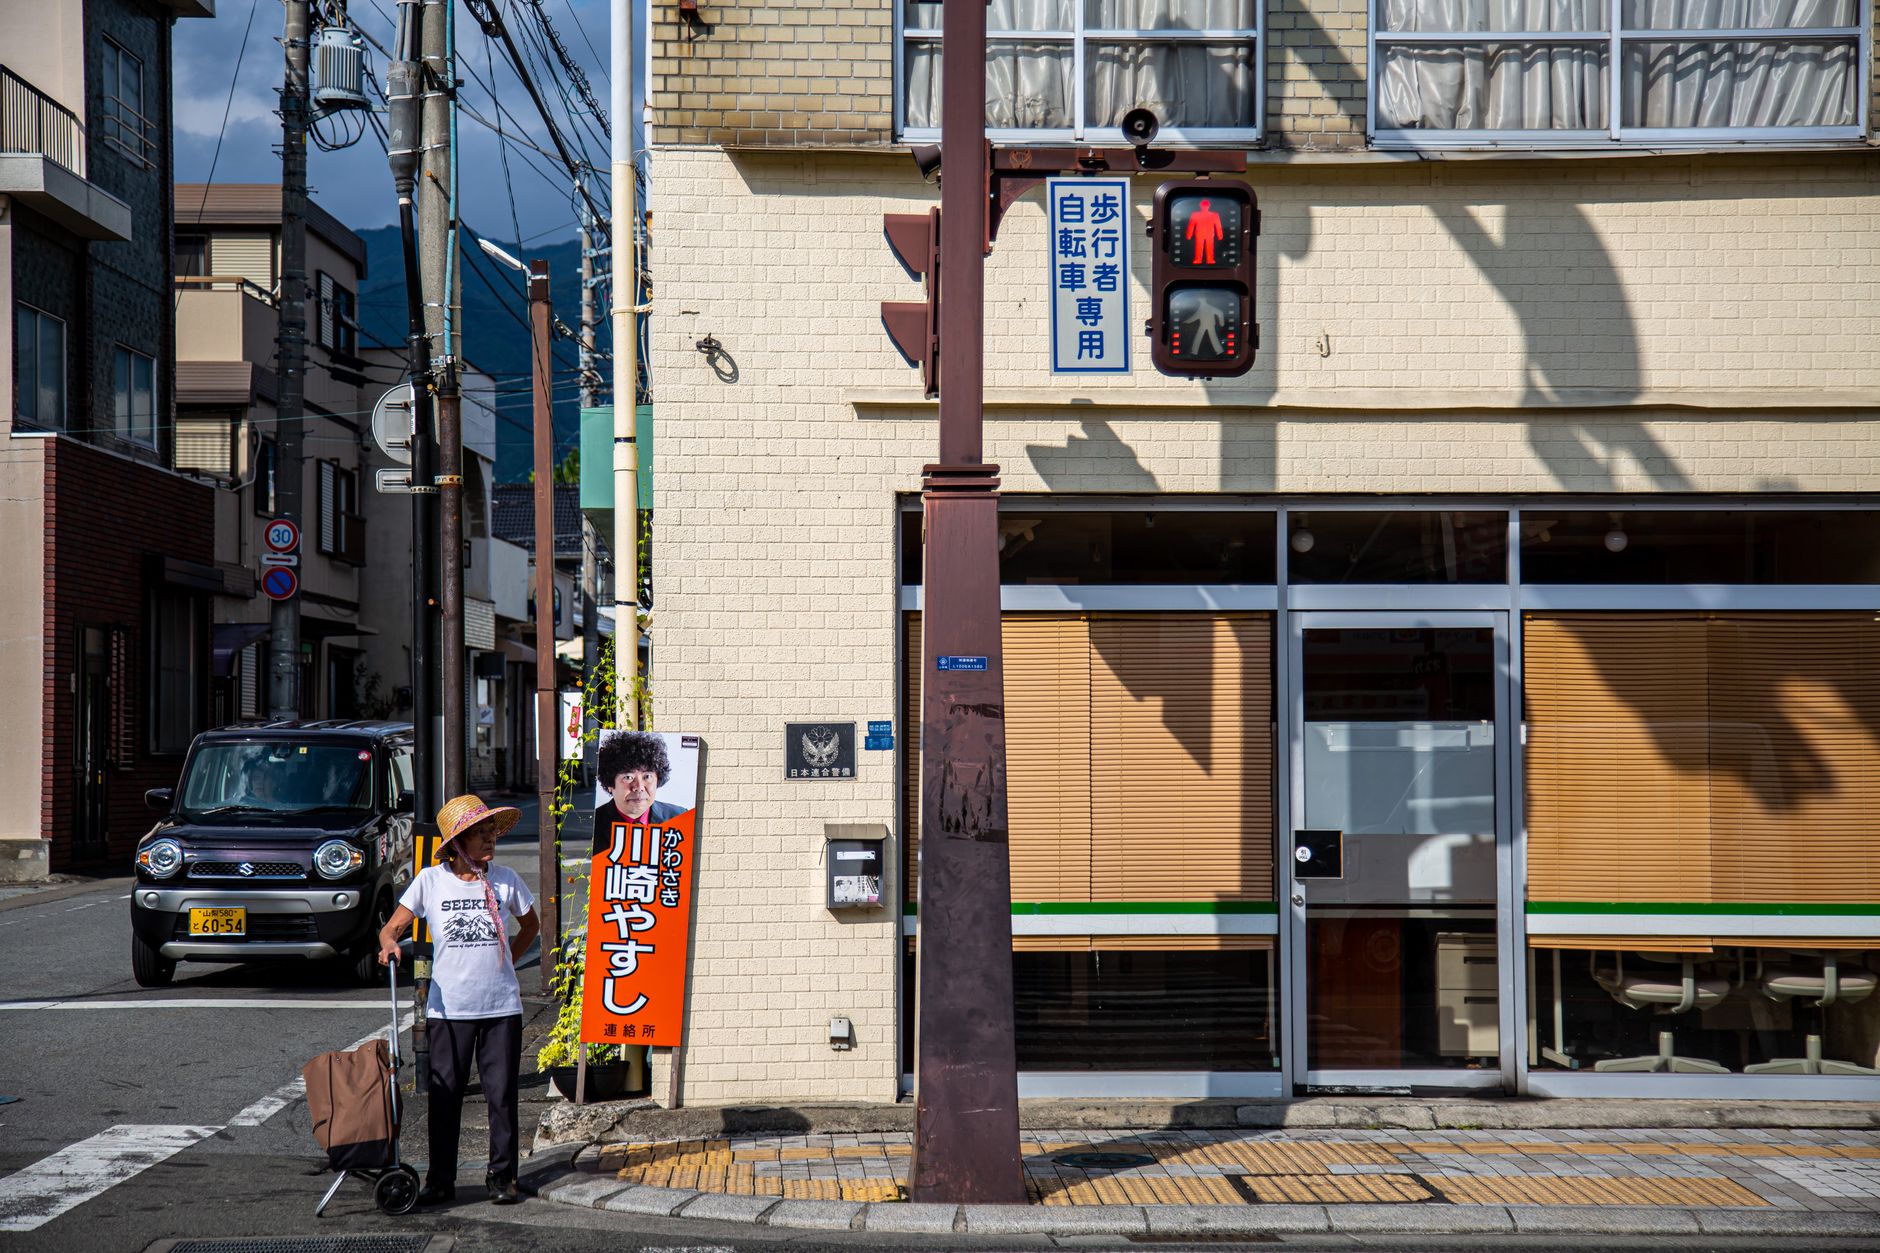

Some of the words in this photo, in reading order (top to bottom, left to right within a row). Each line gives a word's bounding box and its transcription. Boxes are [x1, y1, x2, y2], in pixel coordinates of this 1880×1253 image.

[1058, 193, 1087, 292] 自転車
[1090, 193, 1120, 292] 歩行者
[1075, 296, 1104, 360] 専用
[272, 529, 291, 544] 30
[790, 767, 851, 777] 日本連合警備
[660, 827, 684, 908] かわさき
[202, 918, 243, 933] 60-54
[601, 825, 662, 1016] 川崎やすし
[603, 1023, 656, 1038] 連絡所
